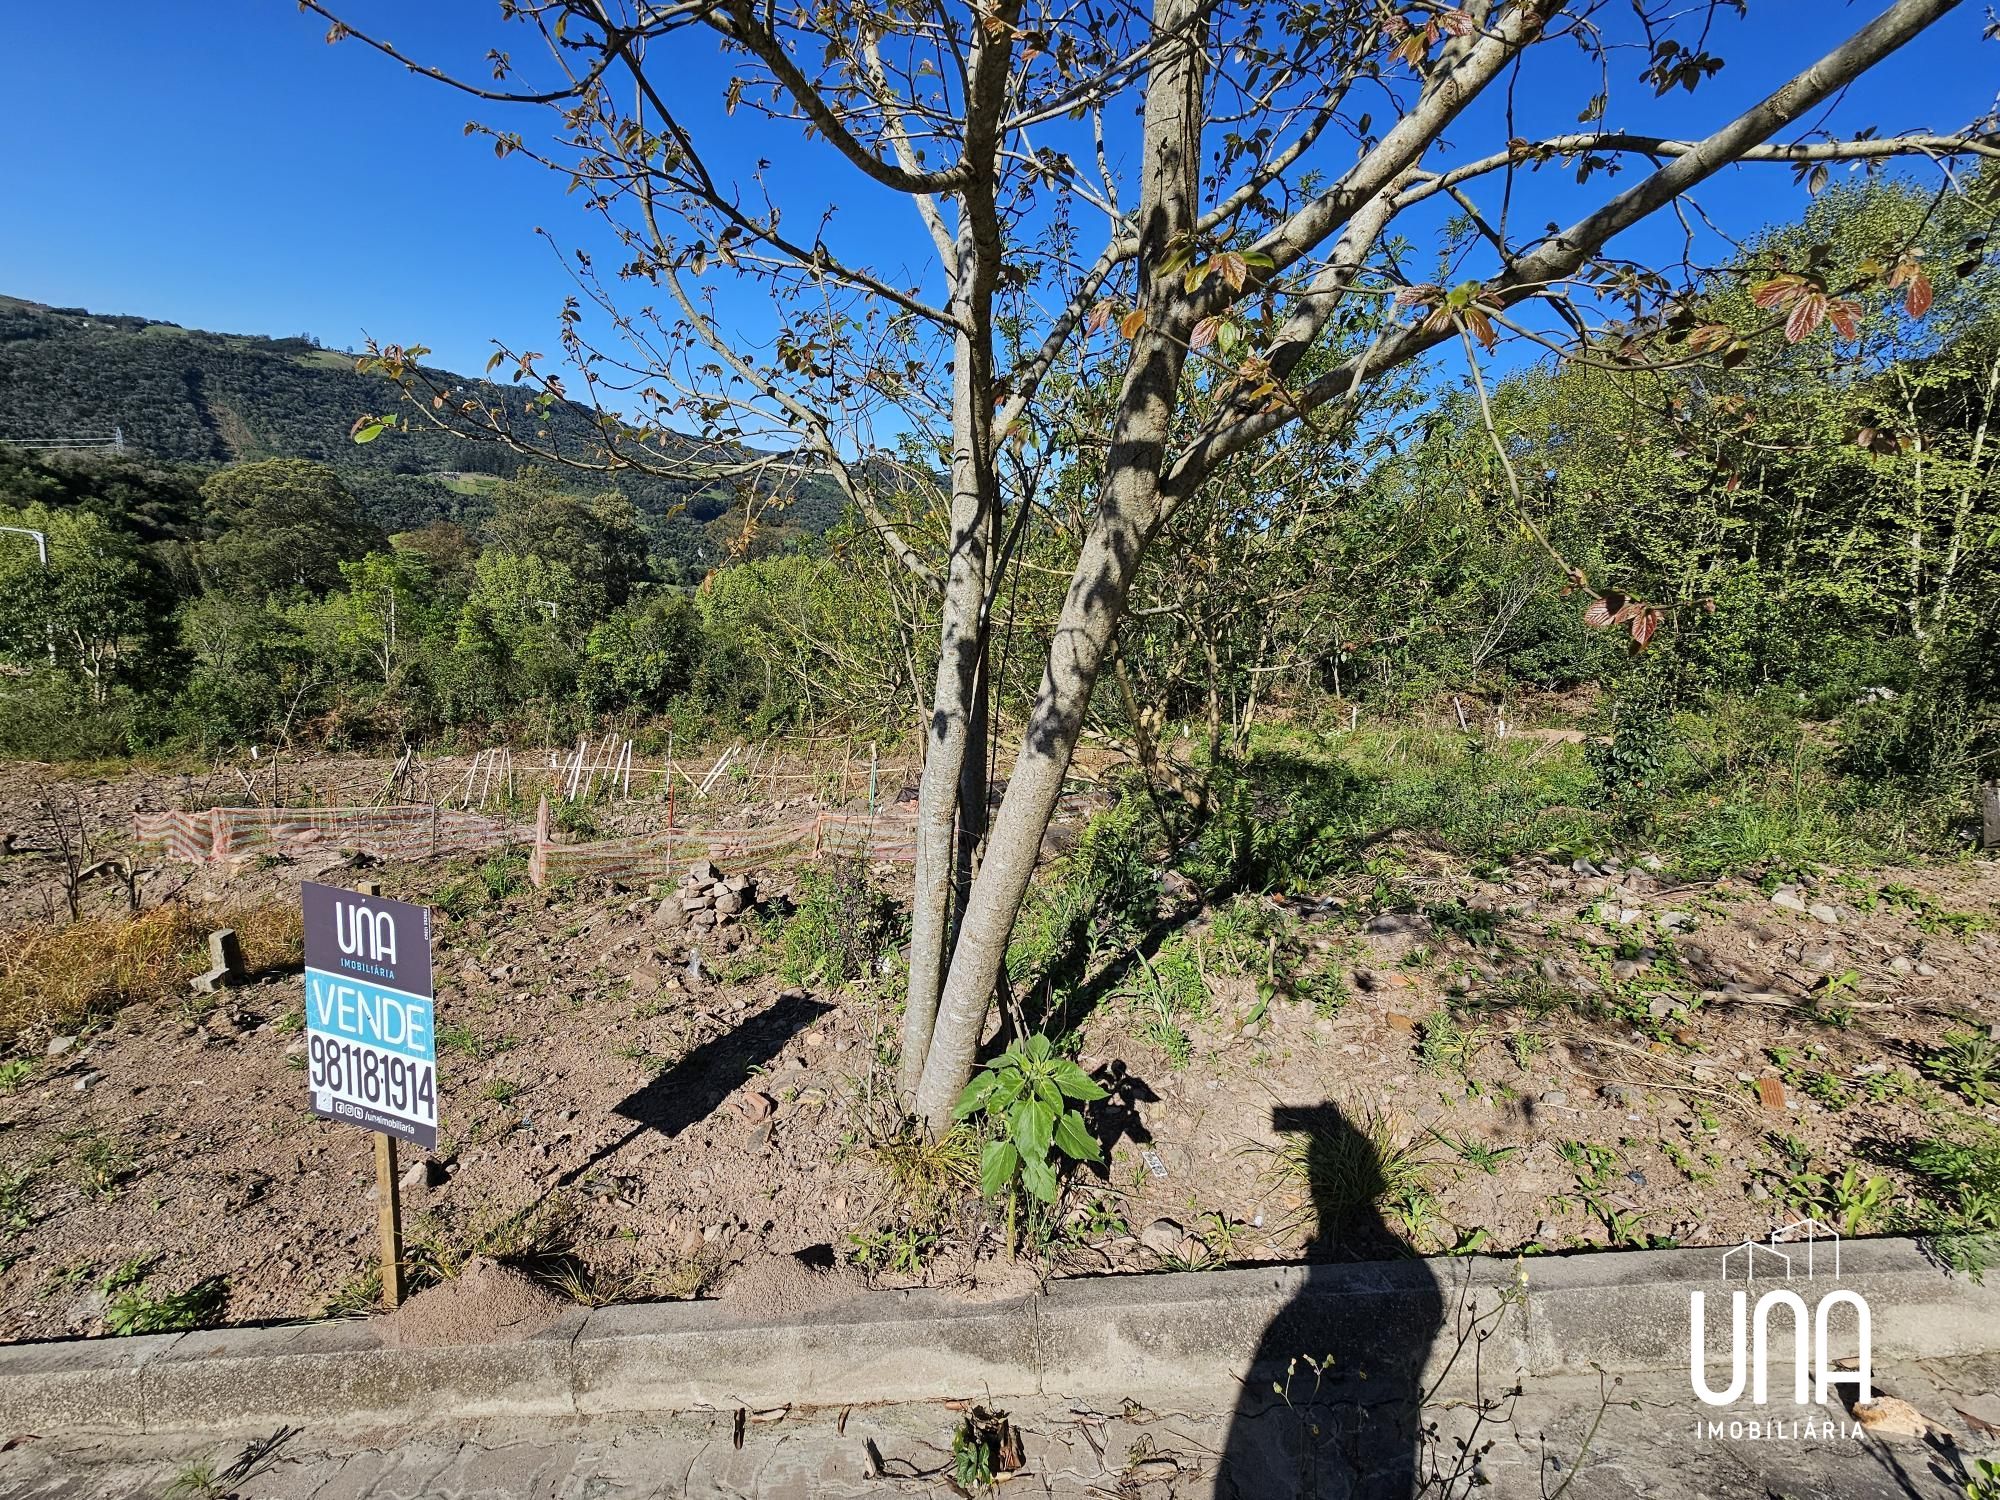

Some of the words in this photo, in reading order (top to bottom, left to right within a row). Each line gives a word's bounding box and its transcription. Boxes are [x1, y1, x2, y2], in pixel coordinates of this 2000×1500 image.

[335, 901, 397, 965] UNA
[340, 957, 395, 979] IMOBILIÁRIA
[312, 979, 426, 1052] VENDE
